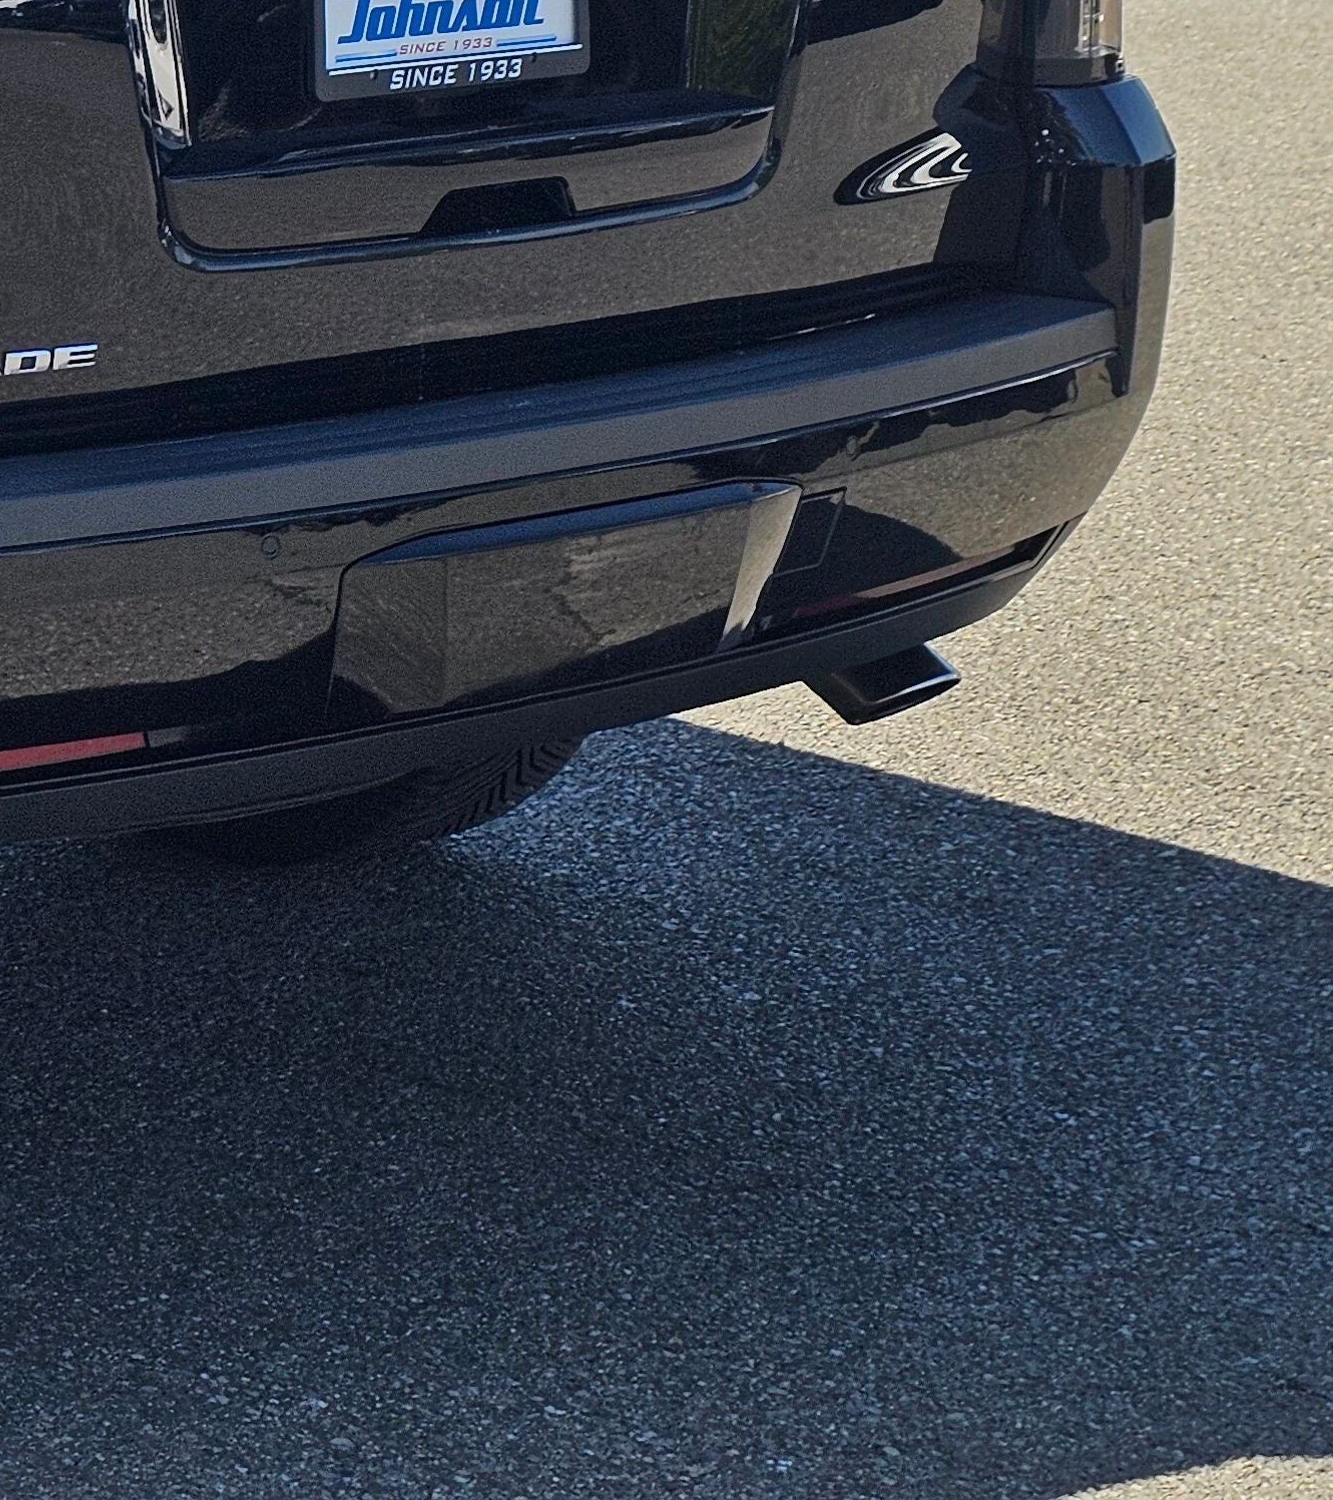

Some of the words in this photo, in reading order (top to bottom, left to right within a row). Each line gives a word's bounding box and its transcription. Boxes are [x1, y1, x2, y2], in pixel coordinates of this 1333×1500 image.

[399, 41, 446, 55] SINCE
[453, 37, 493, 51] 1933
[390, 63, 460, 89] SINCE
[468, 58, 523, 82] 1933
